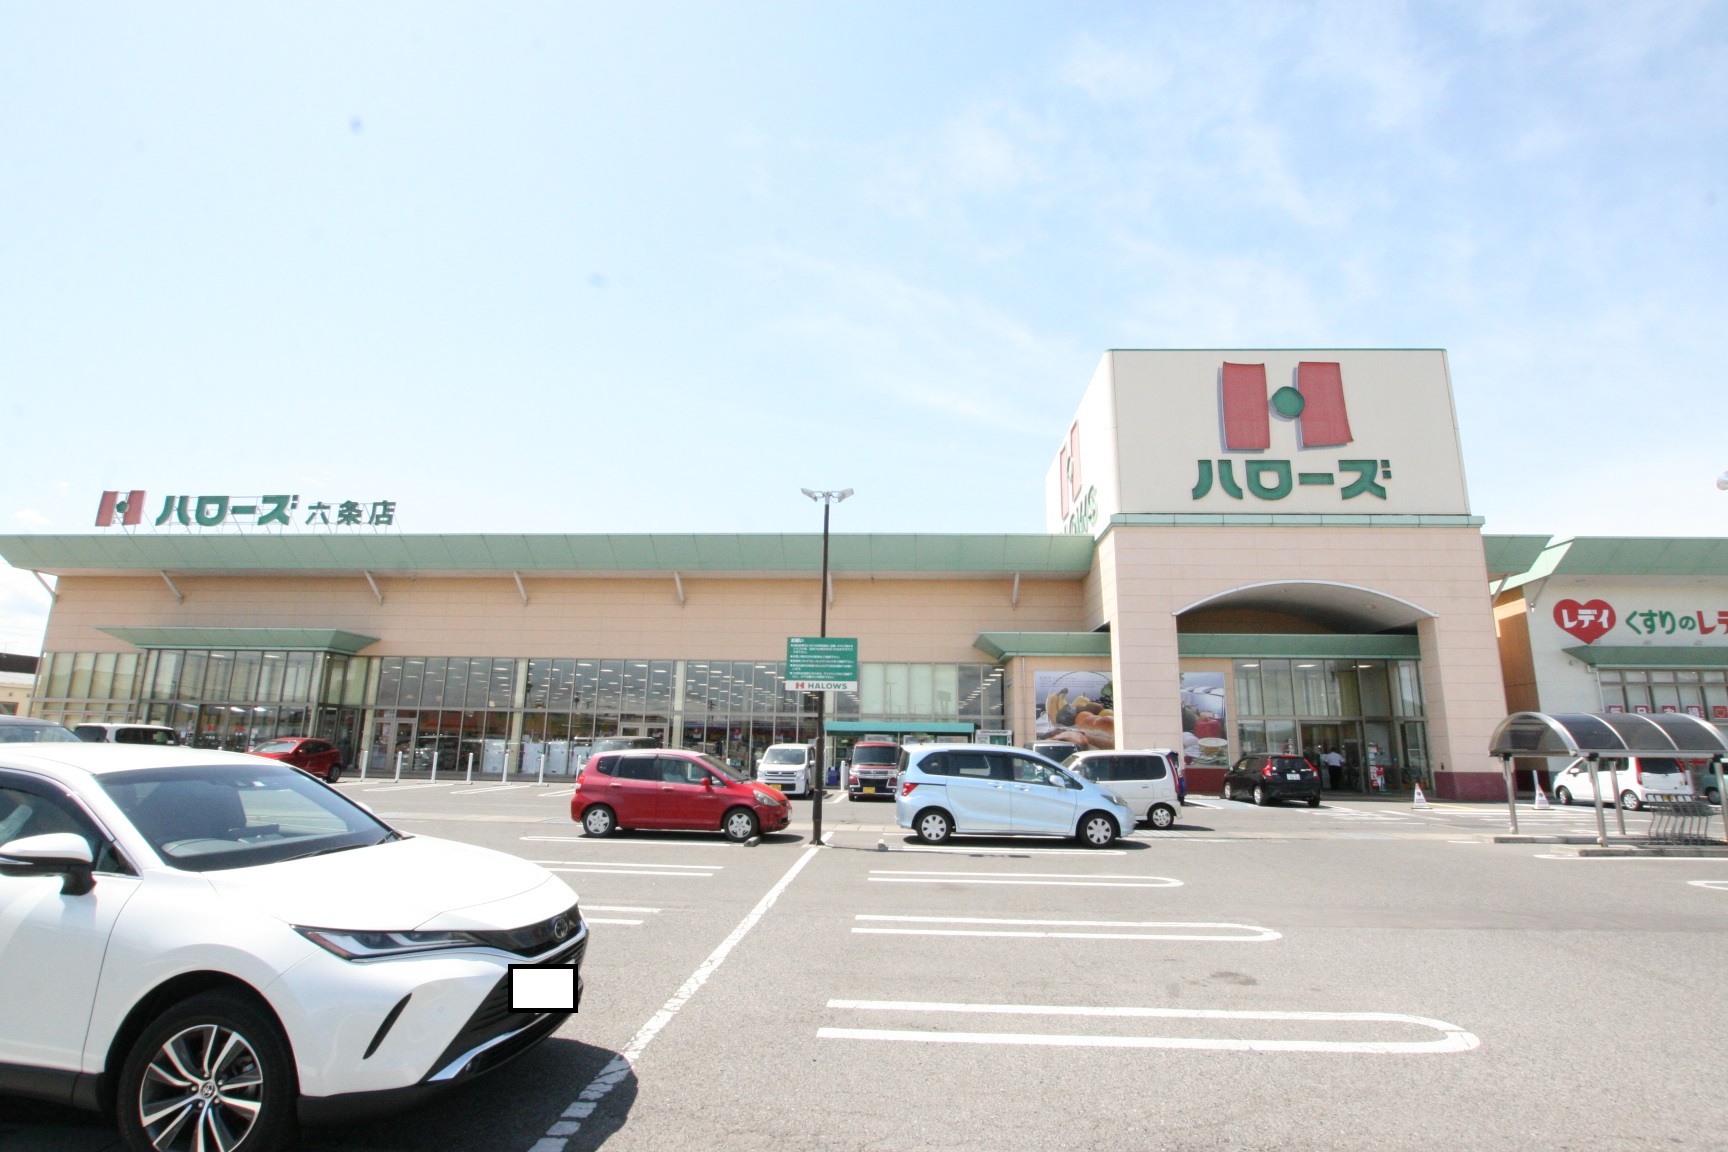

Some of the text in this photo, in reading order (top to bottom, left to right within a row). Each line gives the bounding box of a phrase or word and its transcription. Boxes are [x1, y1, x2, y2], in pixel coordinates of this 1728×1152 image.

[1192, 459, 1392, 500] ハローズ
[155, 495, 396, 526] ハローズ 六条店
